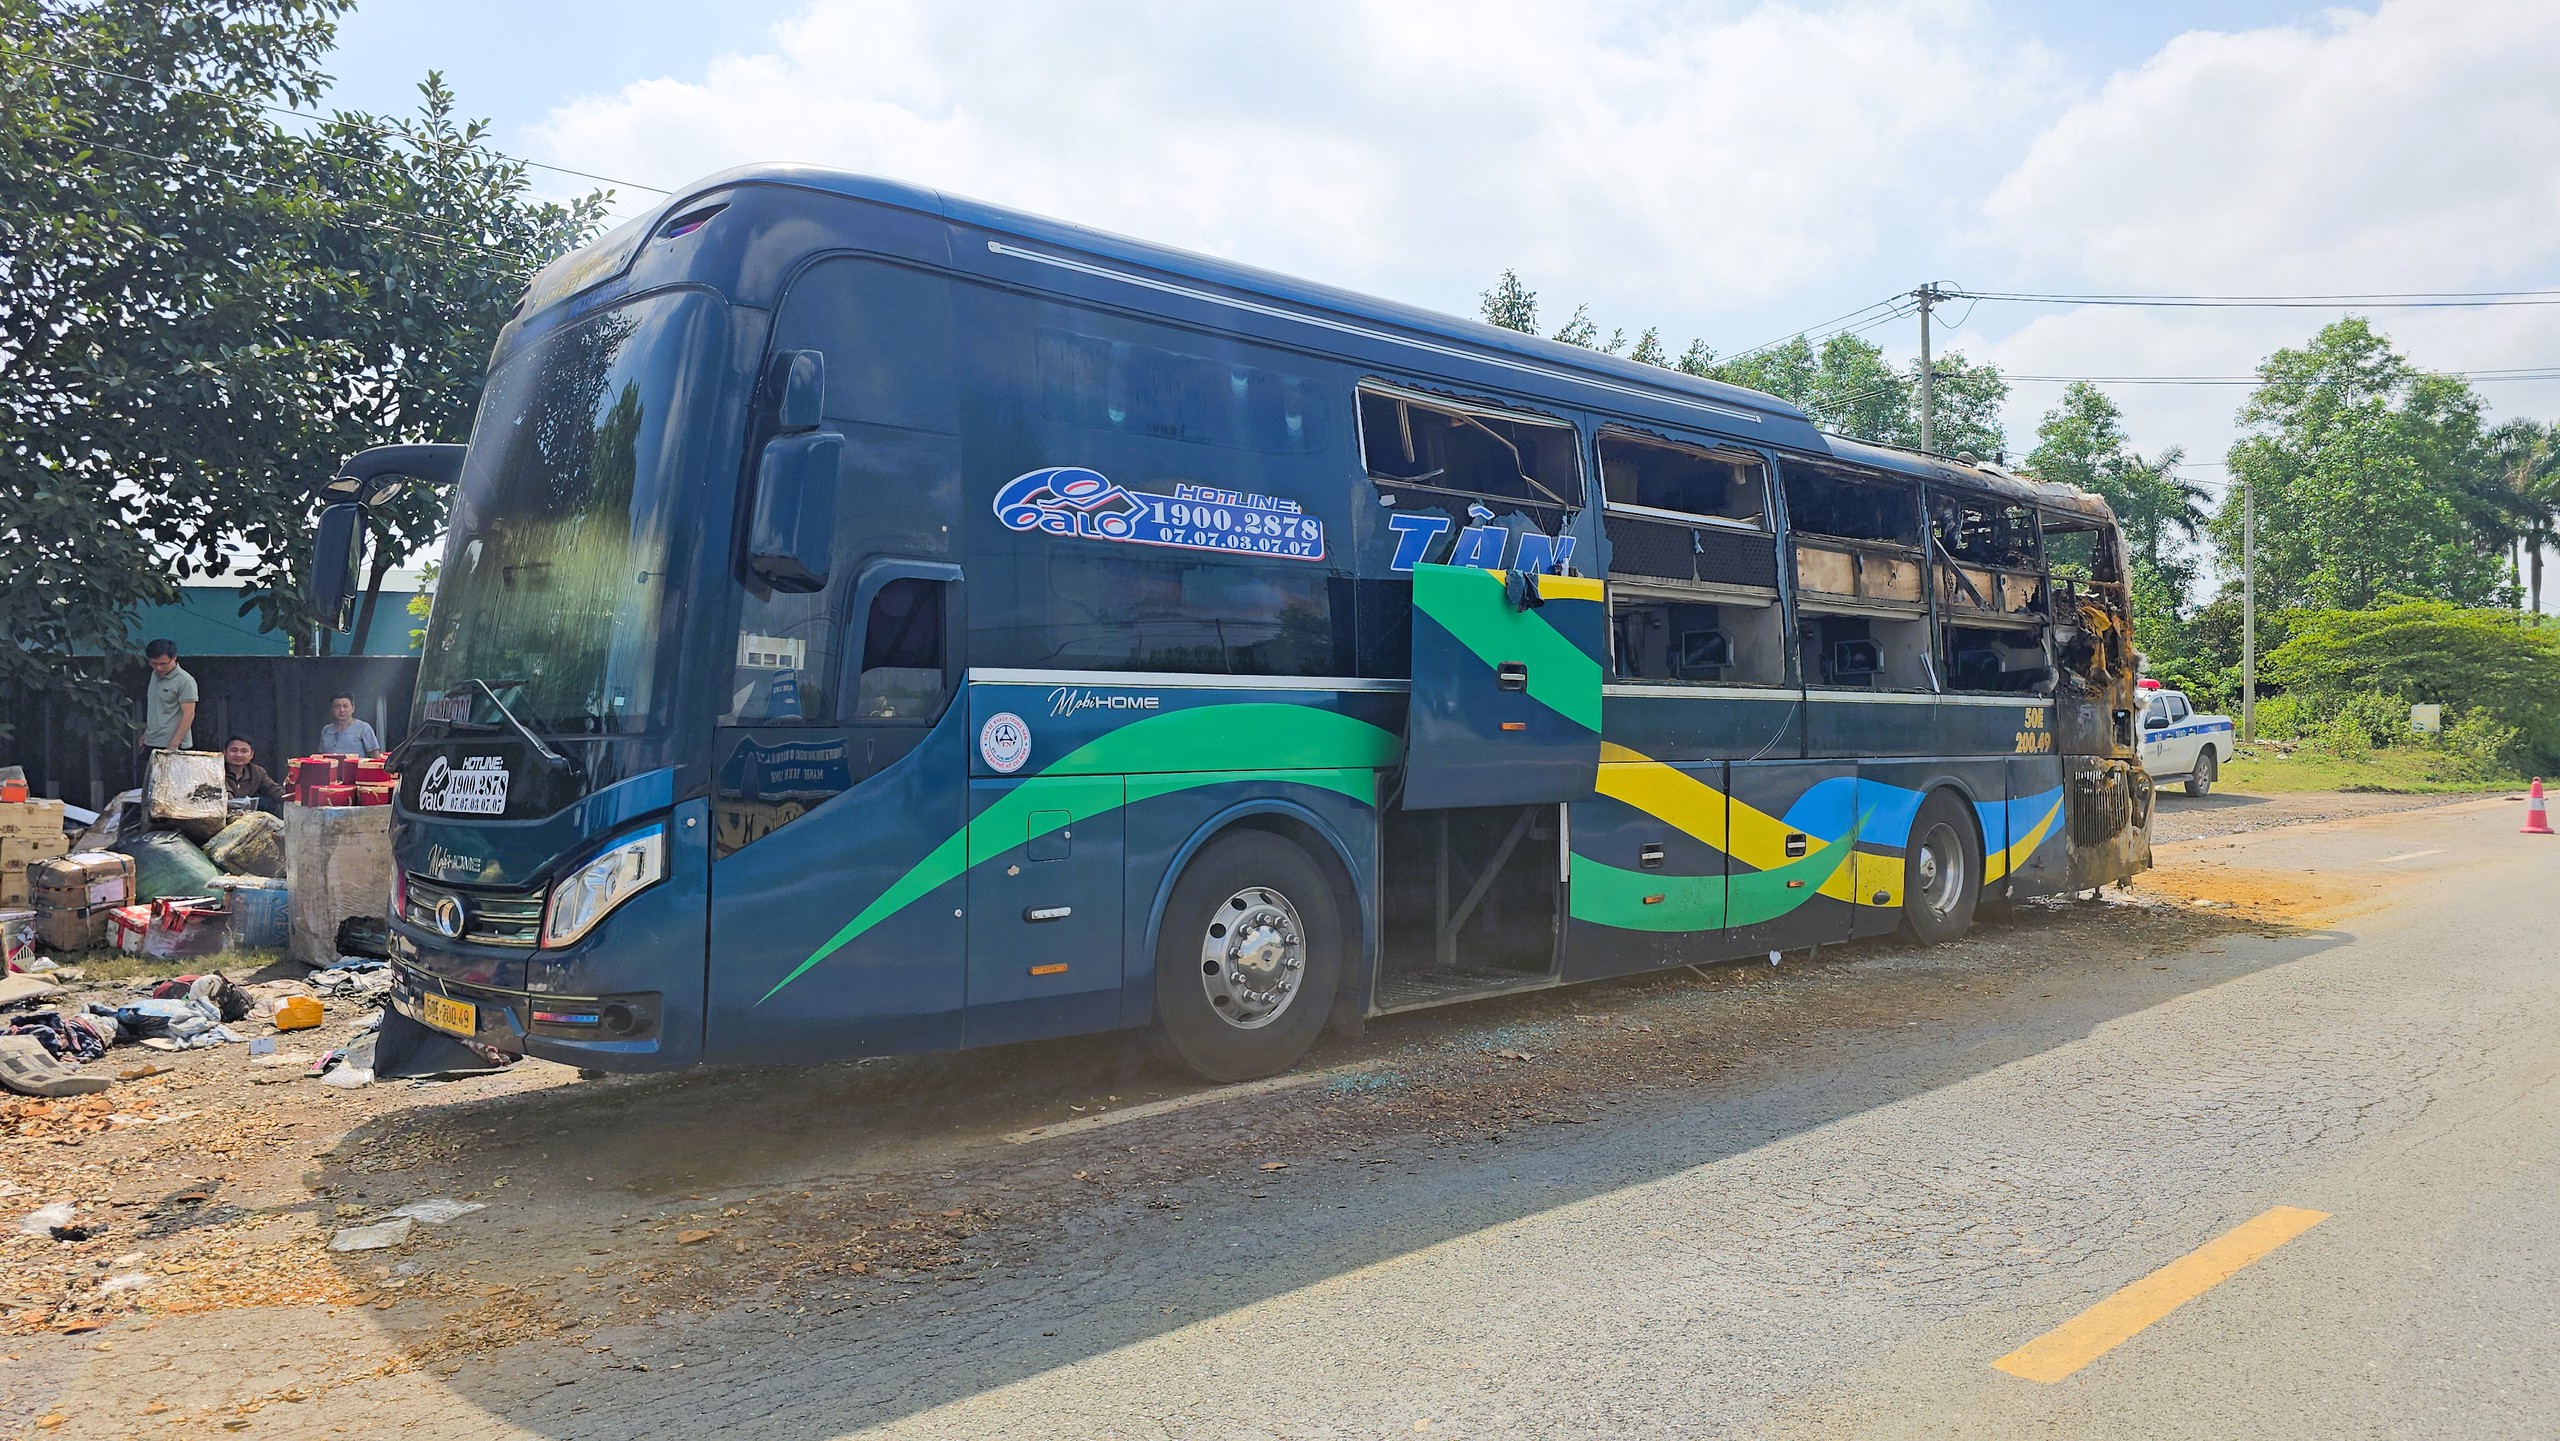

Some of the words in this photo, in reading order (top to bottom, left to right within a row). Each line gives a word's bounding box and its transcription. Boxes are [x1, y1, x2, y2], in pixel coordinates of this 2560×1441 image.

[1175, 483, 1303, 515] HOTLINE:
[1150, 501, 1319, 541] 1900.2878
[1159, 527, 1312, 556] 07.07.03.07.07
[2024, 707, 2044, 729] 50E
[462, 756, 504, 771] HOTLINE:
[451, 775, 507, 796] 1900.2878
